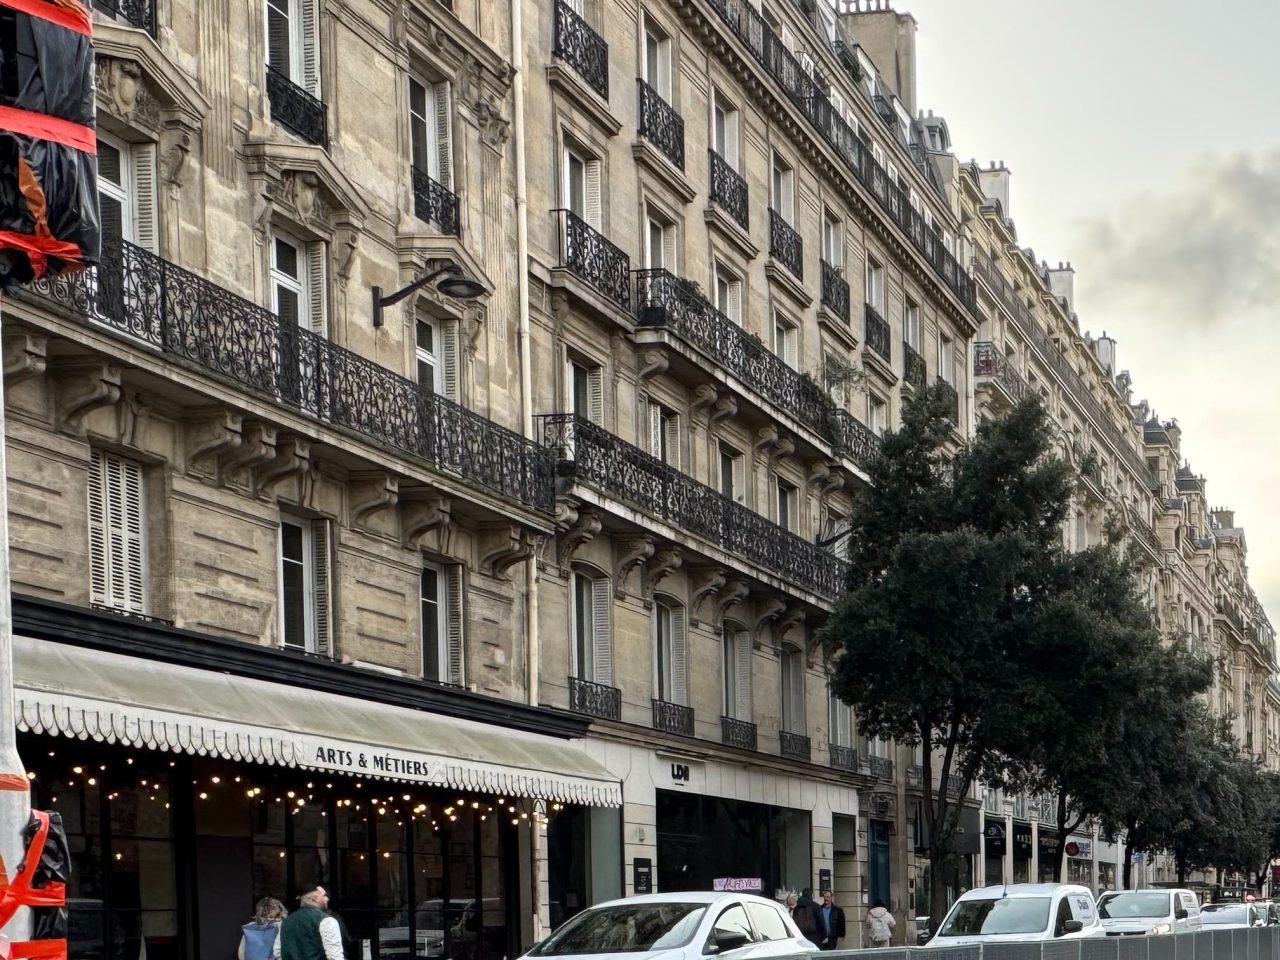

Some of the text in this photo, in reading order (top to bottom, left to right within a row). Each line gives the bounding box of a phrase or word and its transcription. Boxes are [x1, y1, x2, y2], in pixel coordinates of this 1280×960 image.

[316, 746, 429, 776] ARTS & MÉTIERS
